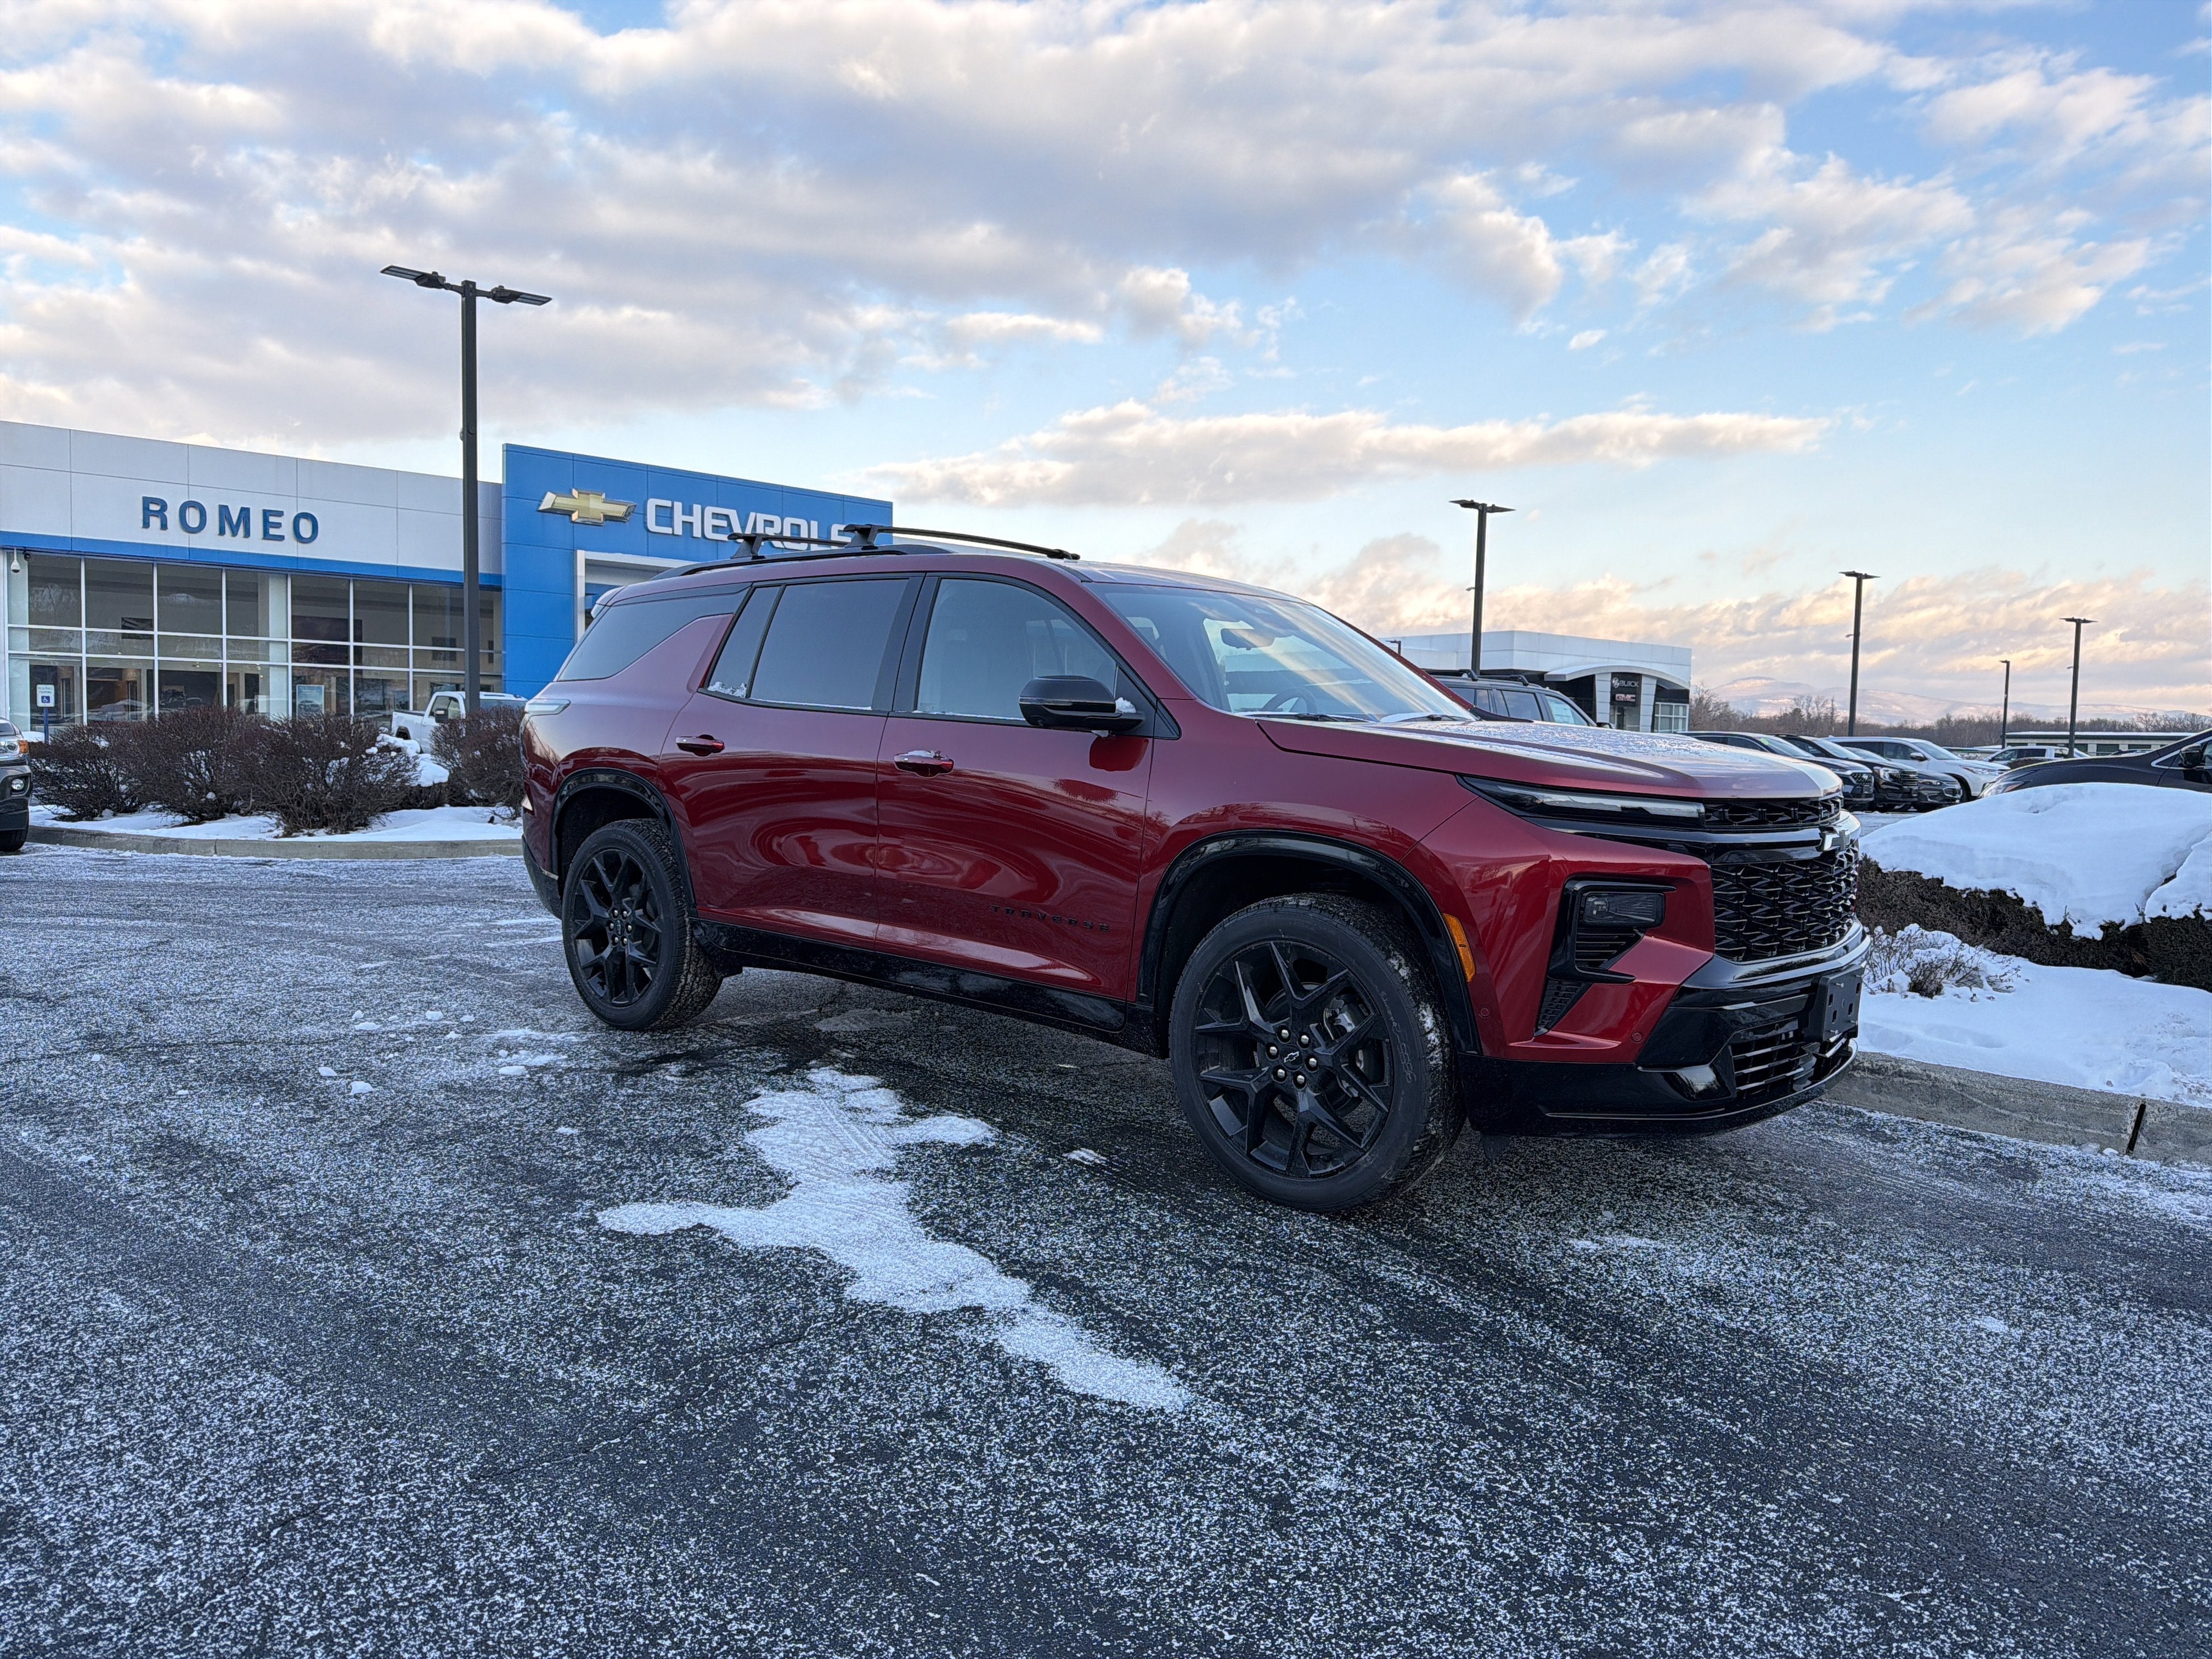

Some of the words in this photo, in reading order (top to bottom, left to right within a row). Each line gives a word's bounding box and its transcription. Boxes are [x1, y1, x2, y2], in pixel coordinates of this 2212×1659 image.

[142, 496, 319, 544] ROMEO
[647, 498, 853, 551] CHEVROLE
[1615, 693, 1636, 702] GMC
[990, 905, 1109, 932] TRAVERSE
